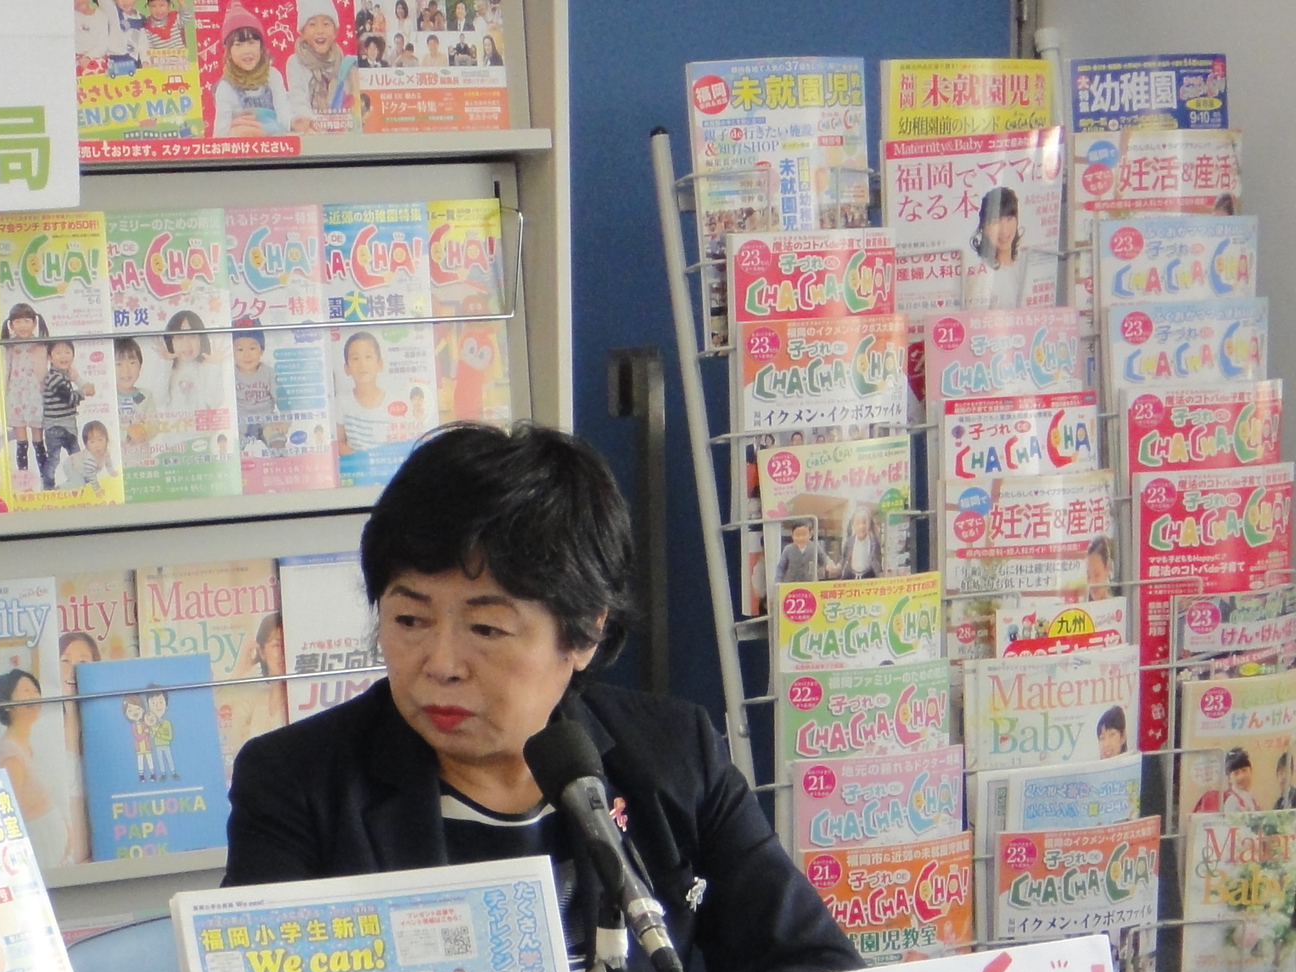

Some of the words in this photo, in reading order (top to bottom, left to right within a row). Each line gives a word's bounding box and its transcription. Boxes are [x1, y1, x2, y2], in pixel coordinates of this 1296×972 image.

[732, 73, 849, 110] 未就園児
[1091, 71, 1178, 112] 幼稚園
[146, 95, 193, 117] MAP
[898, 116, 999, 136] 幼稚園前のトレンド
[1114, 237, 1133, 252] 23
[741, 250, 761, 266] 23
[114, 308, 150, 327] 防災
[938, 328, 954, 343] 21
[1124, 320, 1143, 337] 23
[750, 337, 770, 353] 23
[1135, 403, 1153, 420] 23
[771, 461, 792, 477] 23
[1147, 487, 1166, 503] 23
[786, 599, 806, 614] 22
[1056, 614, 1088, 636] 九州
[1191, 610, 1212, 627] 23
[791, 687, 811, 702] 22
[987, 665, 1138, 713] Maternity
[1205, 695, 1224, 711] 23
[988, 715, 1085, 762] Baby
[808, 776, 825, 791] 21
[111, 796, 206, 821] FUKUOKA
[113, 821, 168, 841] PAPA
[1007, 847, 1026, 863] 23
[813, 864, 830, 881] 21
[201, 914, 381, 951] 福岡小学生新聞
